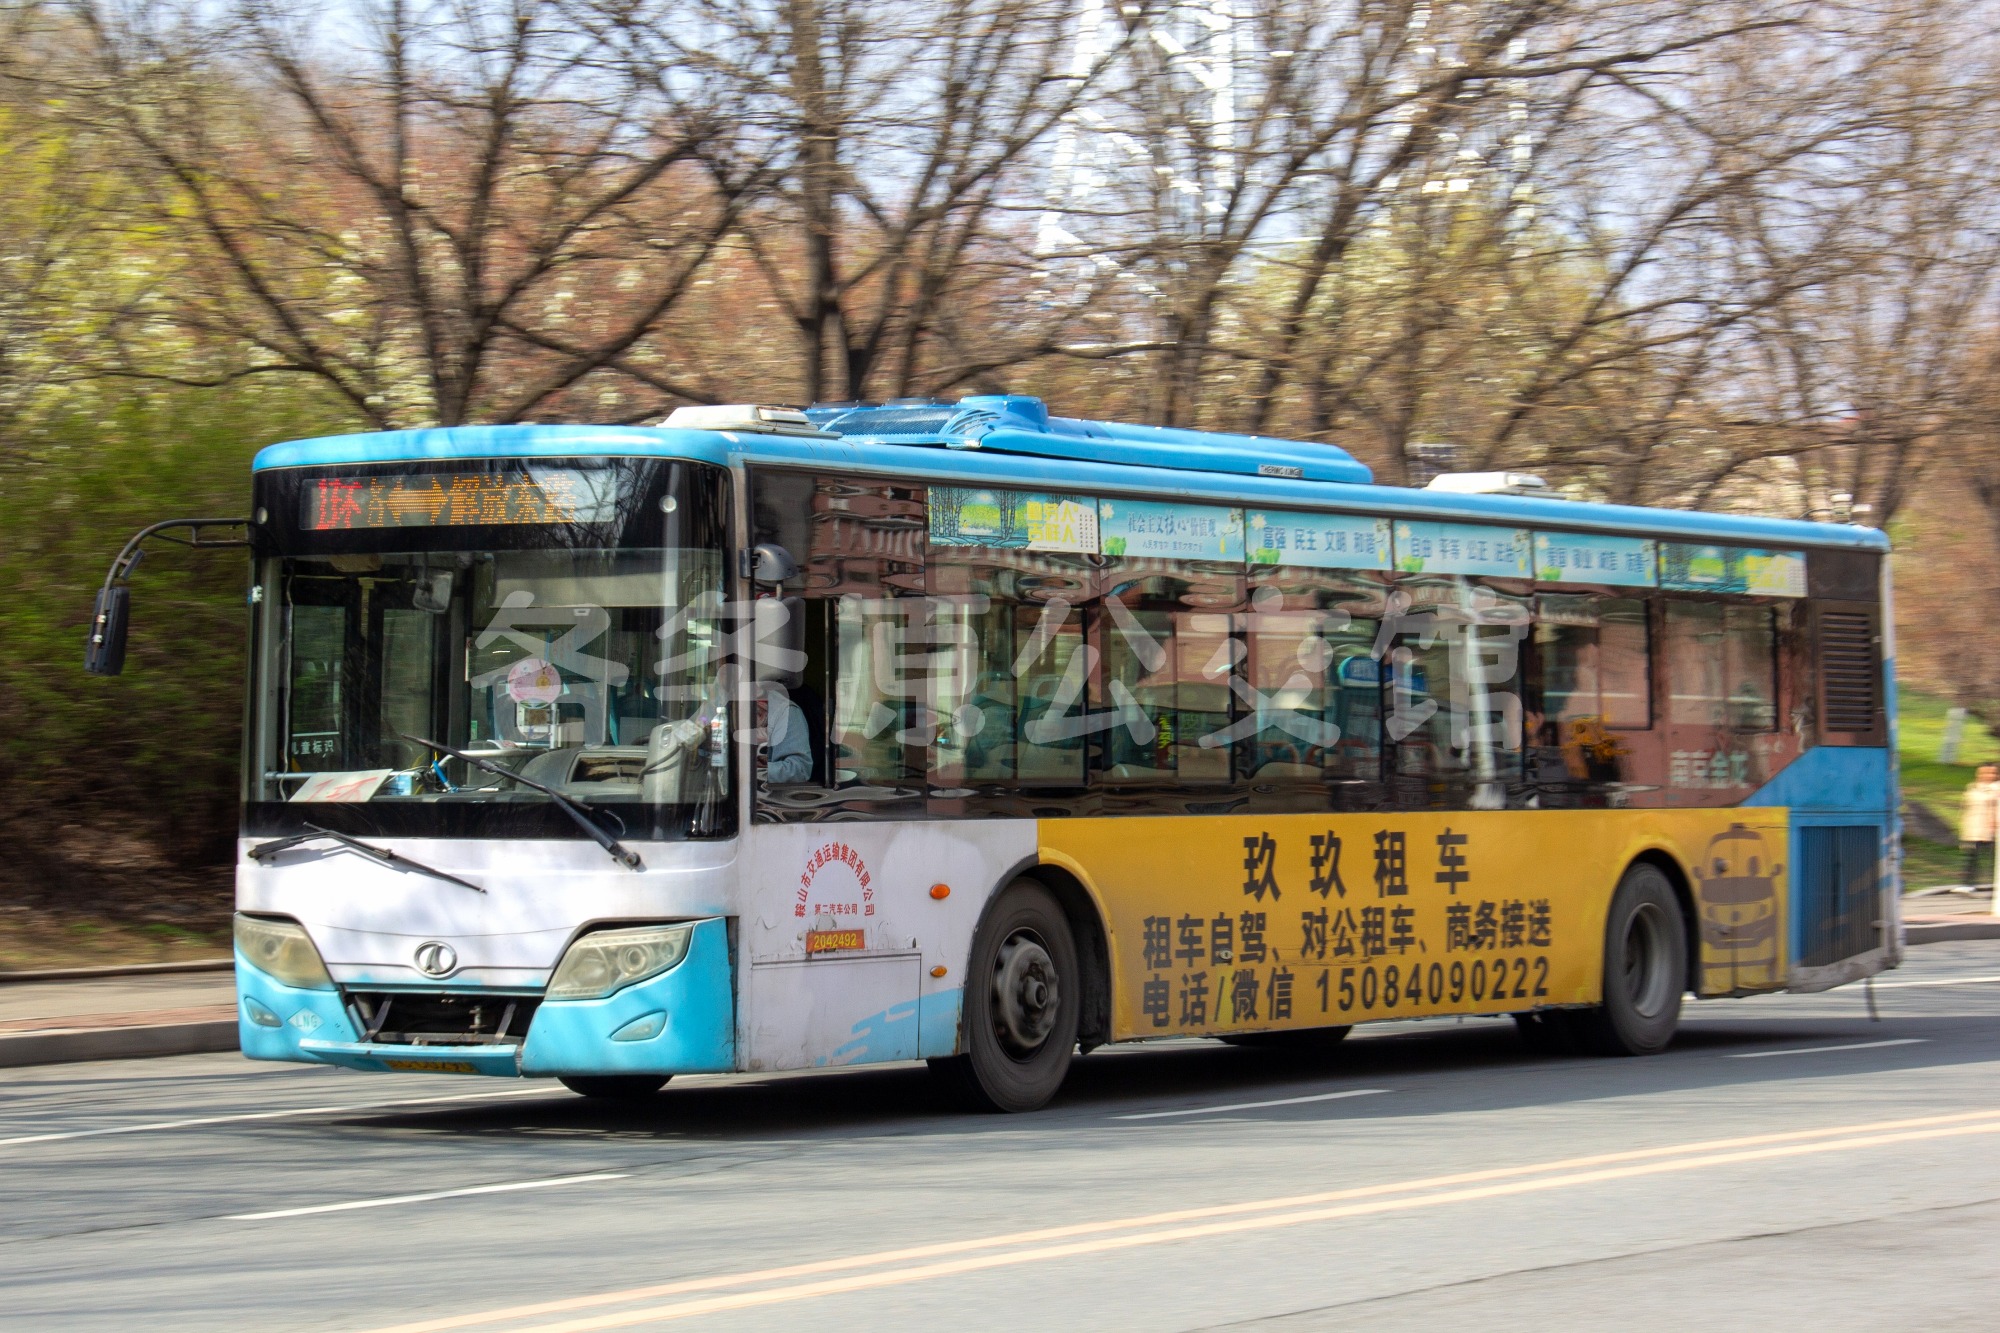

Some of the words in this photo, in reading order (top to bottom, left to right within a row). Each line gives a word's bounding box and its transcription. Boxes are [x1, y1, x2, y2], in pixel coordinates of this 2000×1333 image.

[794, 841, 875, 918] 鞍山市交通运输集团有限公司
[1242, 825, 1471, 903] 玖玖租车
[814, 903, 858, 916] 第二汽车公司
[813, 932, 857, 949] 2042492
[1315, 955, 1551, 1014] 15084090222
